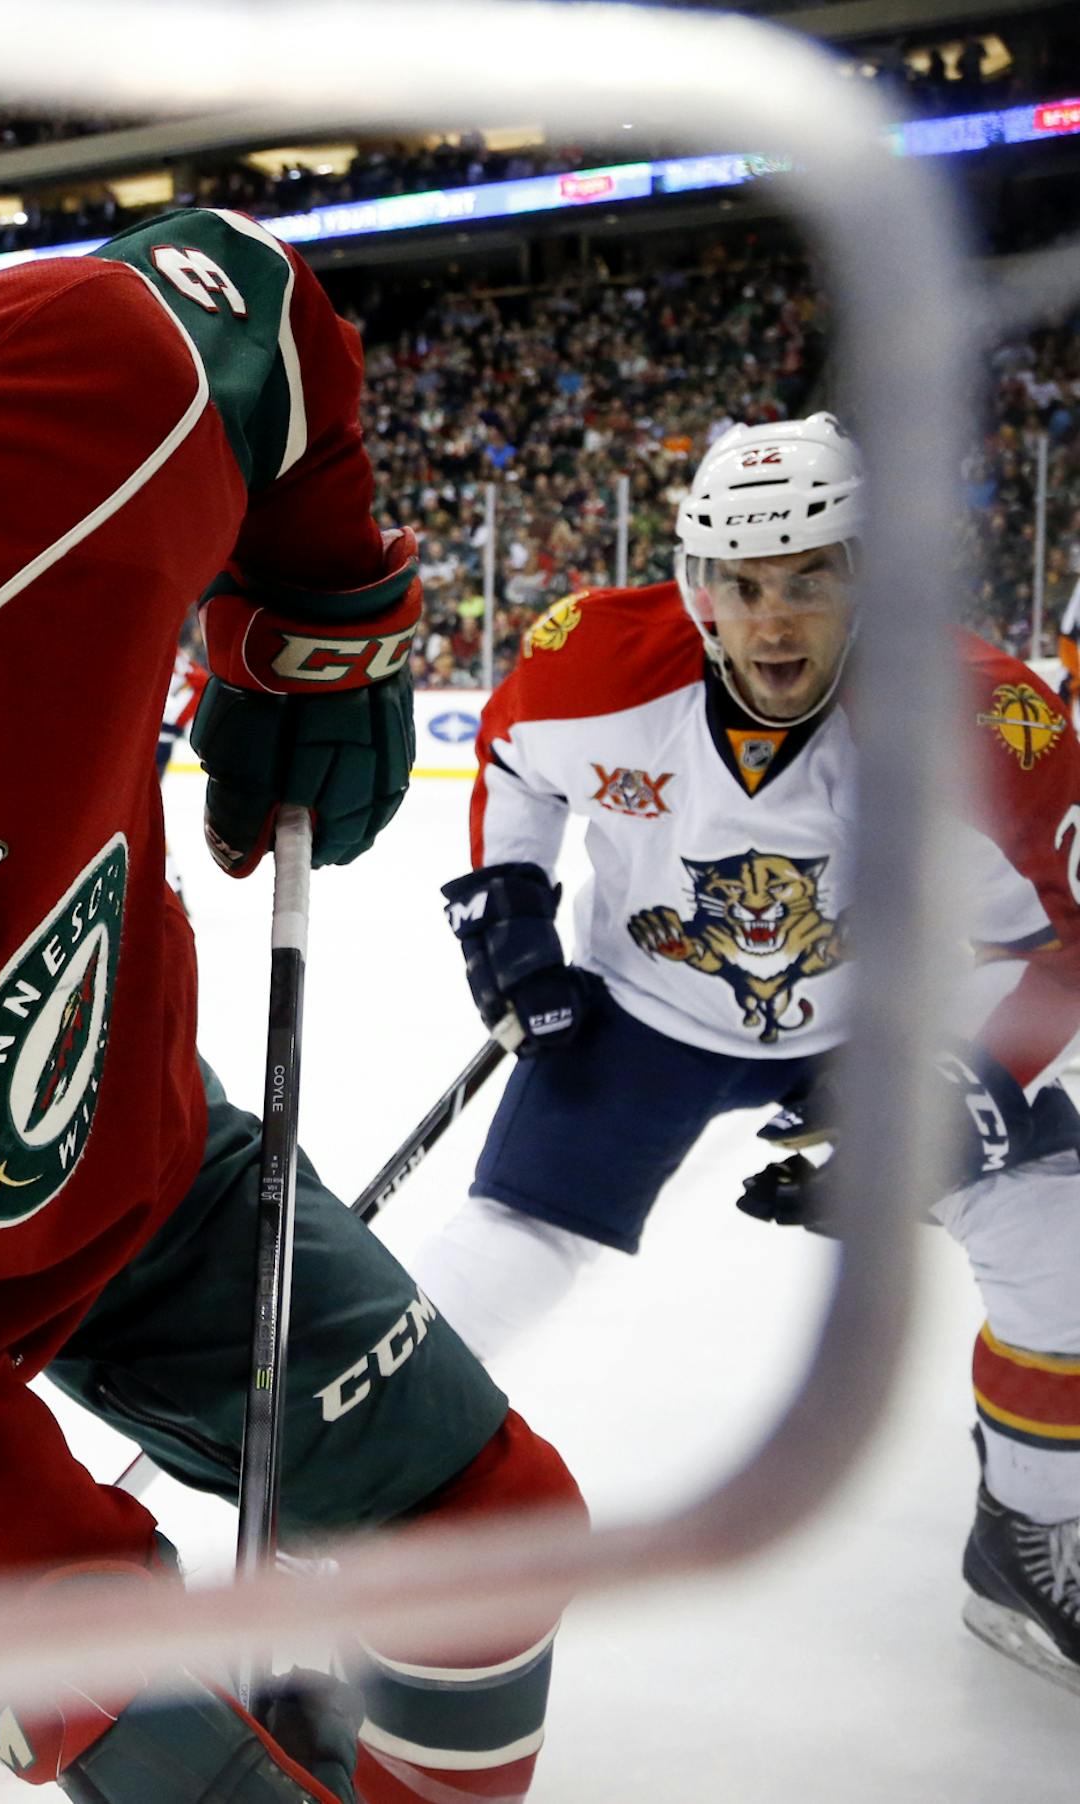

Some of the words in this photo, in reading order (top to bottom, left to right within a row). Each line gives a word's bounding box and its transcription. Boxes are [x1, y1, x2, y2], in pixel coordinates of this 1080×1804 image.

[151, 244, 248, 319] 3
[742, 447, 782, 468] 22
[726, 510, 791, 526] CCM
[272, 1065, 285, 1112] COYLE
[312, 1285, 437, 1422] CCM
